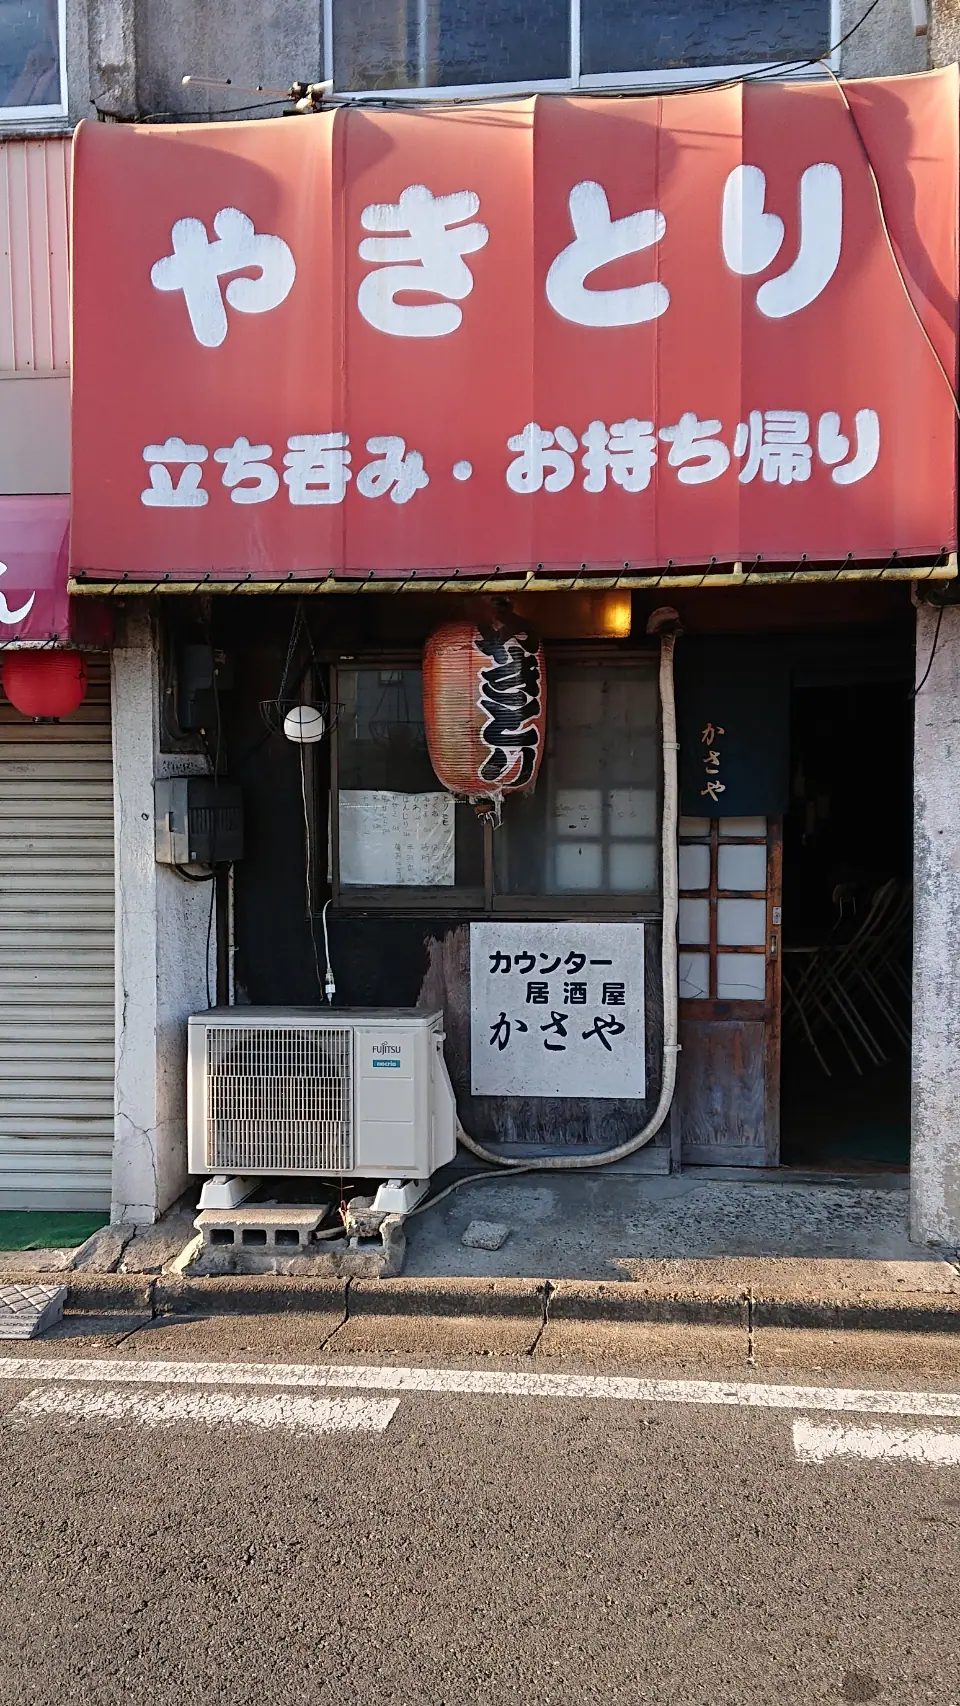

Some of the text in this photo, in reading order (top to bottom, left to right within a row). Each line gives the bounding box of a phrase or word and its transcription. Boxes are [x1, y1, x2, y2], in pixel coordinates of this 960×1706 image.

[150, 162, 844, 347] やきとり
[472, 622, 541, 788] やきとり
[701, 722, 726, 802] かさや
[489, 951, 613, 974] カウンター
[525, 982, 626, 1005] 居酒屋
[372, 1041, 401, 1055] FUJITSU
[489, 1010, 625, 1051] かさや
